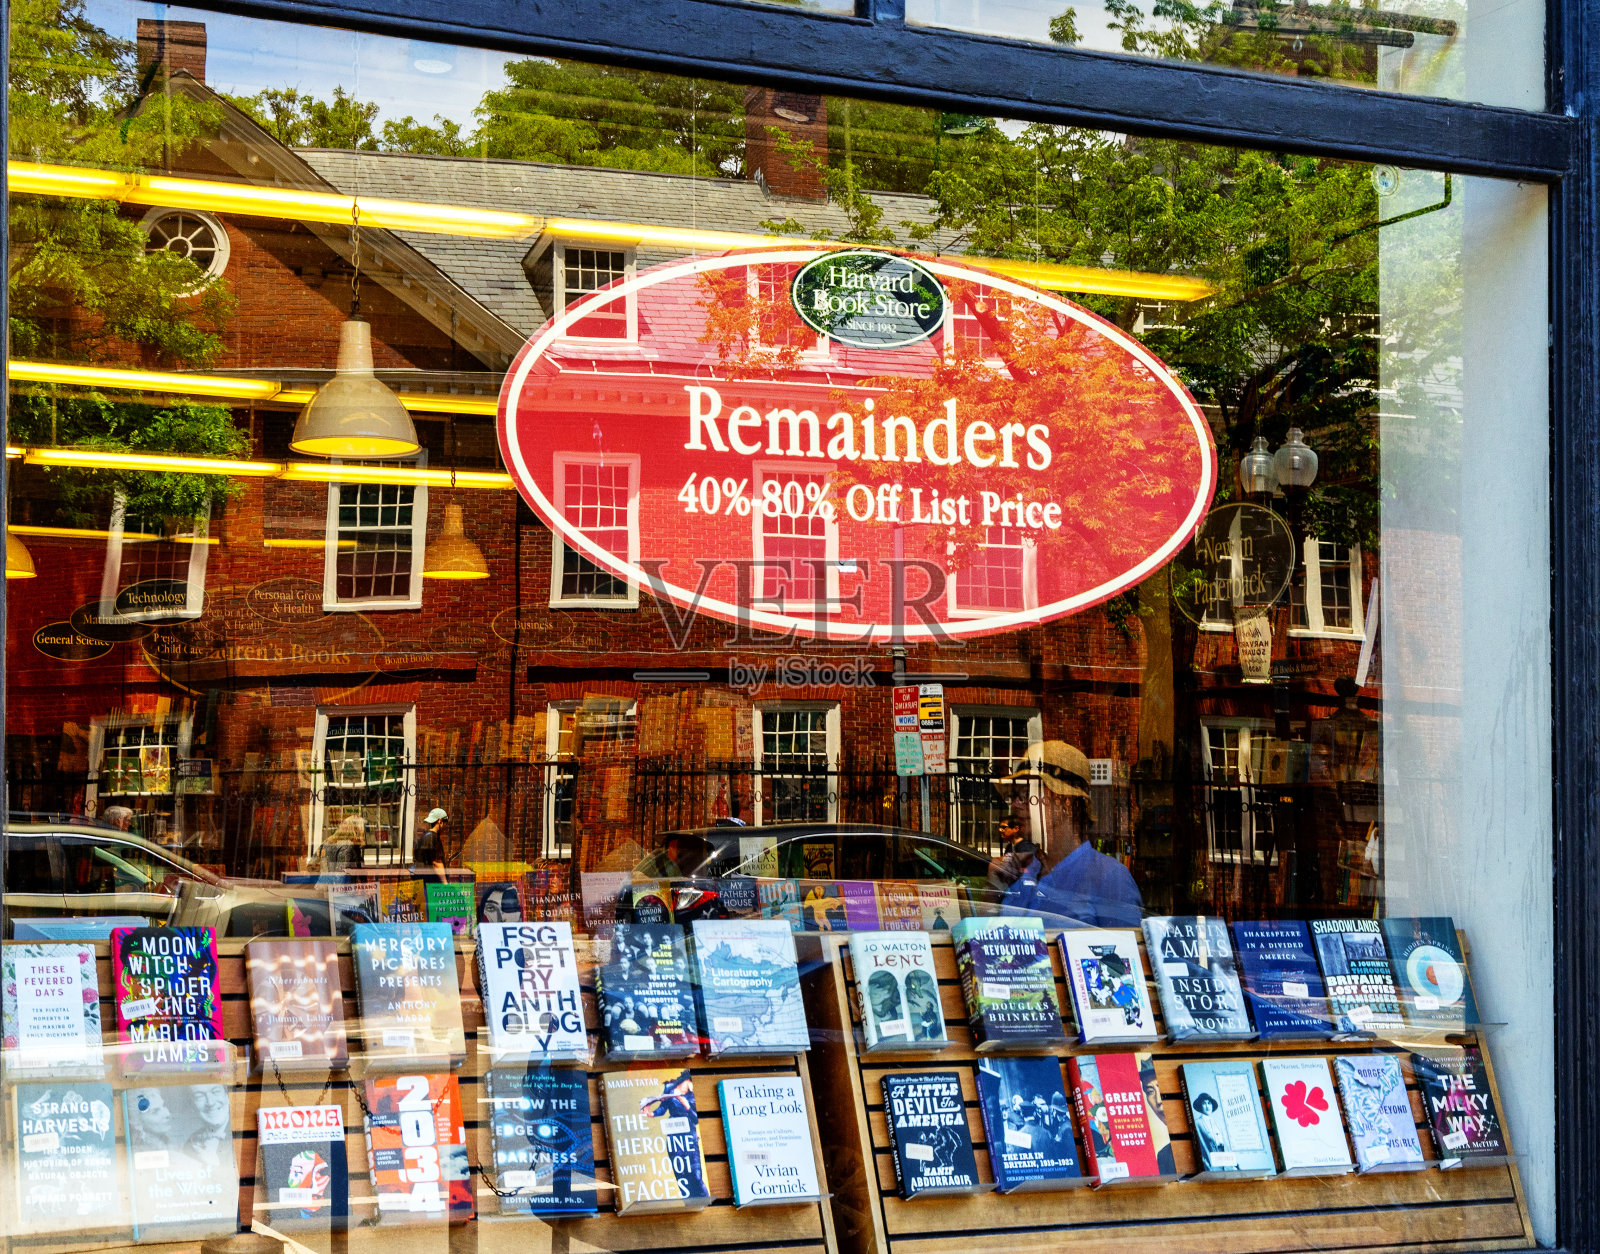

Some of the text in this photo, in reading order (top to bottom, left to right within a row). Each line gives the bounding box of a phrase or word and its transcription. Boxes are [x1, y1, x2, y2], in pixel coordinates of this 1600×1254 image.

[829, 266, 914, 293] Harvard
[812, 289, 930, 319] Book Store
[846, 320, 897, 333] SINCE 1932
[683, 385, 1053, 471] Remainders
[677, 472, 1062, 529] 40%-80% Off List Price
[126, 591, 186, 604] Technology
[254, 589, 294, 601] Personal
[283, 603, 314, 614] Health
[514, 618, 553, 631] Business
[36, 632, 110, 647] General Science
[291, 643, 351, 665] Books
[385, 655, 408, 665] Board
[327, 727, 363, 736] Graduation
[132, 735, 164, 744] Everyday
[743, 854, 776, 863] ATLAS
[743, 862, 776, 870] PARADOX
[730, 881, 742, 889] MY
[531, 893, 581, 905] TIANANMEN
[720, 890, 755, 898] FATHER'S
[882, 893, 886, 902] I
[921, 887, 950, 898] Death
[724, 899, 752, 907] HOUSE
[923, 898, 950, 909] Valley
[383, 912, 425, 923] MEASURE
[540, 907, 574, 918] SQUARE
[639, 907, 662, 916] LONDON
[1160, 925, 1224, 937] MARTIN
[1313, 919, 1380, 933] SHADOWLANDS
[502, 926, 557, 947] FSG
[974, 929, 1040, 940] SILENT SPRING
[142, 936, 196, 956] MOON
[365, 937, 447, 952] MERCURY
[864, 943, 927, 952] JO WALTON
[984, 944, 1037, 955] REVOLUTION
[1163, 939, 1230, 958] AMIS
[1429, 940, 1455, 956] SPRING
[372, 957, 445, 971] PICTURES
[495, 947, 569, 969] POET
[873, 954, 925, 968] LENT
[31, 965, 65, 974] THESE
[129, 956, 188, 975] WITCH
[711, 968, 759, 977] Literature
[25, 977, 73, 986] FEVERED
[379, 976, 442, 988] PRESENTS
[517, 969, 553, 990] RY
[713, 977, 773, 988] Cartography
[1170, 978, 1239, 993] INSIDE
[1326, 974, 1393, 986] BRITAIN'S
[35, 989, 64, 997] DAYS
[140, 977, 211, 997] SPIDER
[1328, 984, 1396, 996] LOST CITIES
[152, 996, 197, 1015] KING
[387, 1001, 437, 1010] ANTHONY
[502, 990, 577, 1012] ANTH
[992, 1002, 1049, 1011] DOUGLAS
[1173, 994, 1240, 1010] STORY
[502, 1011, 582, 1035] OLOG
[989, 1012, 1055, 1022] BRINKLEY
[1194, 1017, 1246, 1030] NOVEL
[130, 1023, 210, 1043] MARLON
[143, 1043, 209, 1063] JAMES
[1357, 1068, 1385, 1078] BORGES
[607, 1078, 659, 1089] MARIA TATAR
[1437, 1074, 1477, 1091] THE
[734, 1084, 795, 1100] Taking a
[891, 1084, 958, 1098] A LITTLE
[1105, 1091, 1141, 1103] GREAT
[32, 1101, 99, 1115] STRANGE
[494, 1097, 577, 1110] BELOW THE
[731, 1100, 803, 1117] Long Look
[893, 1097, 961, 1115] DEVIL In
[1431, 1093, 1489, 1113] MILKY
[1109, 1104, 1144, 1116] STATE
[1379, 1105, 1408, 1115] BEYOND
[22, 1118, 110, 1134] HARVESTS
[612, 1114, 650, 1132] THE
[896, 1113, 964, 1128] AMERICA
[1446, 1114, 1486, 1132] WAY
[496, 1125, 559, 1137] EDGE OF
[1115, 1132, 1147, 1140] TIMOTHY
[617, 1135, 696, 1156] HEROINE
[1472, 1140, 1499, 1148] McTIER
[497, 1152, 578, 1164] DARKNESS
[1002, 1153, 1018, 1161] THE
[1035, 1152, 1044, 1160] IN
[620, 1156, 692, 1177] WITH 1,001
[754, 1164, 798, 1178] Vivian
[923, 1166, 954, 1176] HANIF
[1003, 1161, 1039, 1169] BRITAIN,
[177, 1181, 223, 1195] Wives
[623, 1178, 691, 1203] FACES
[751, 1180, 807, 1195] Gornick
[529, 1196, 562, 1204] WIDDER,
